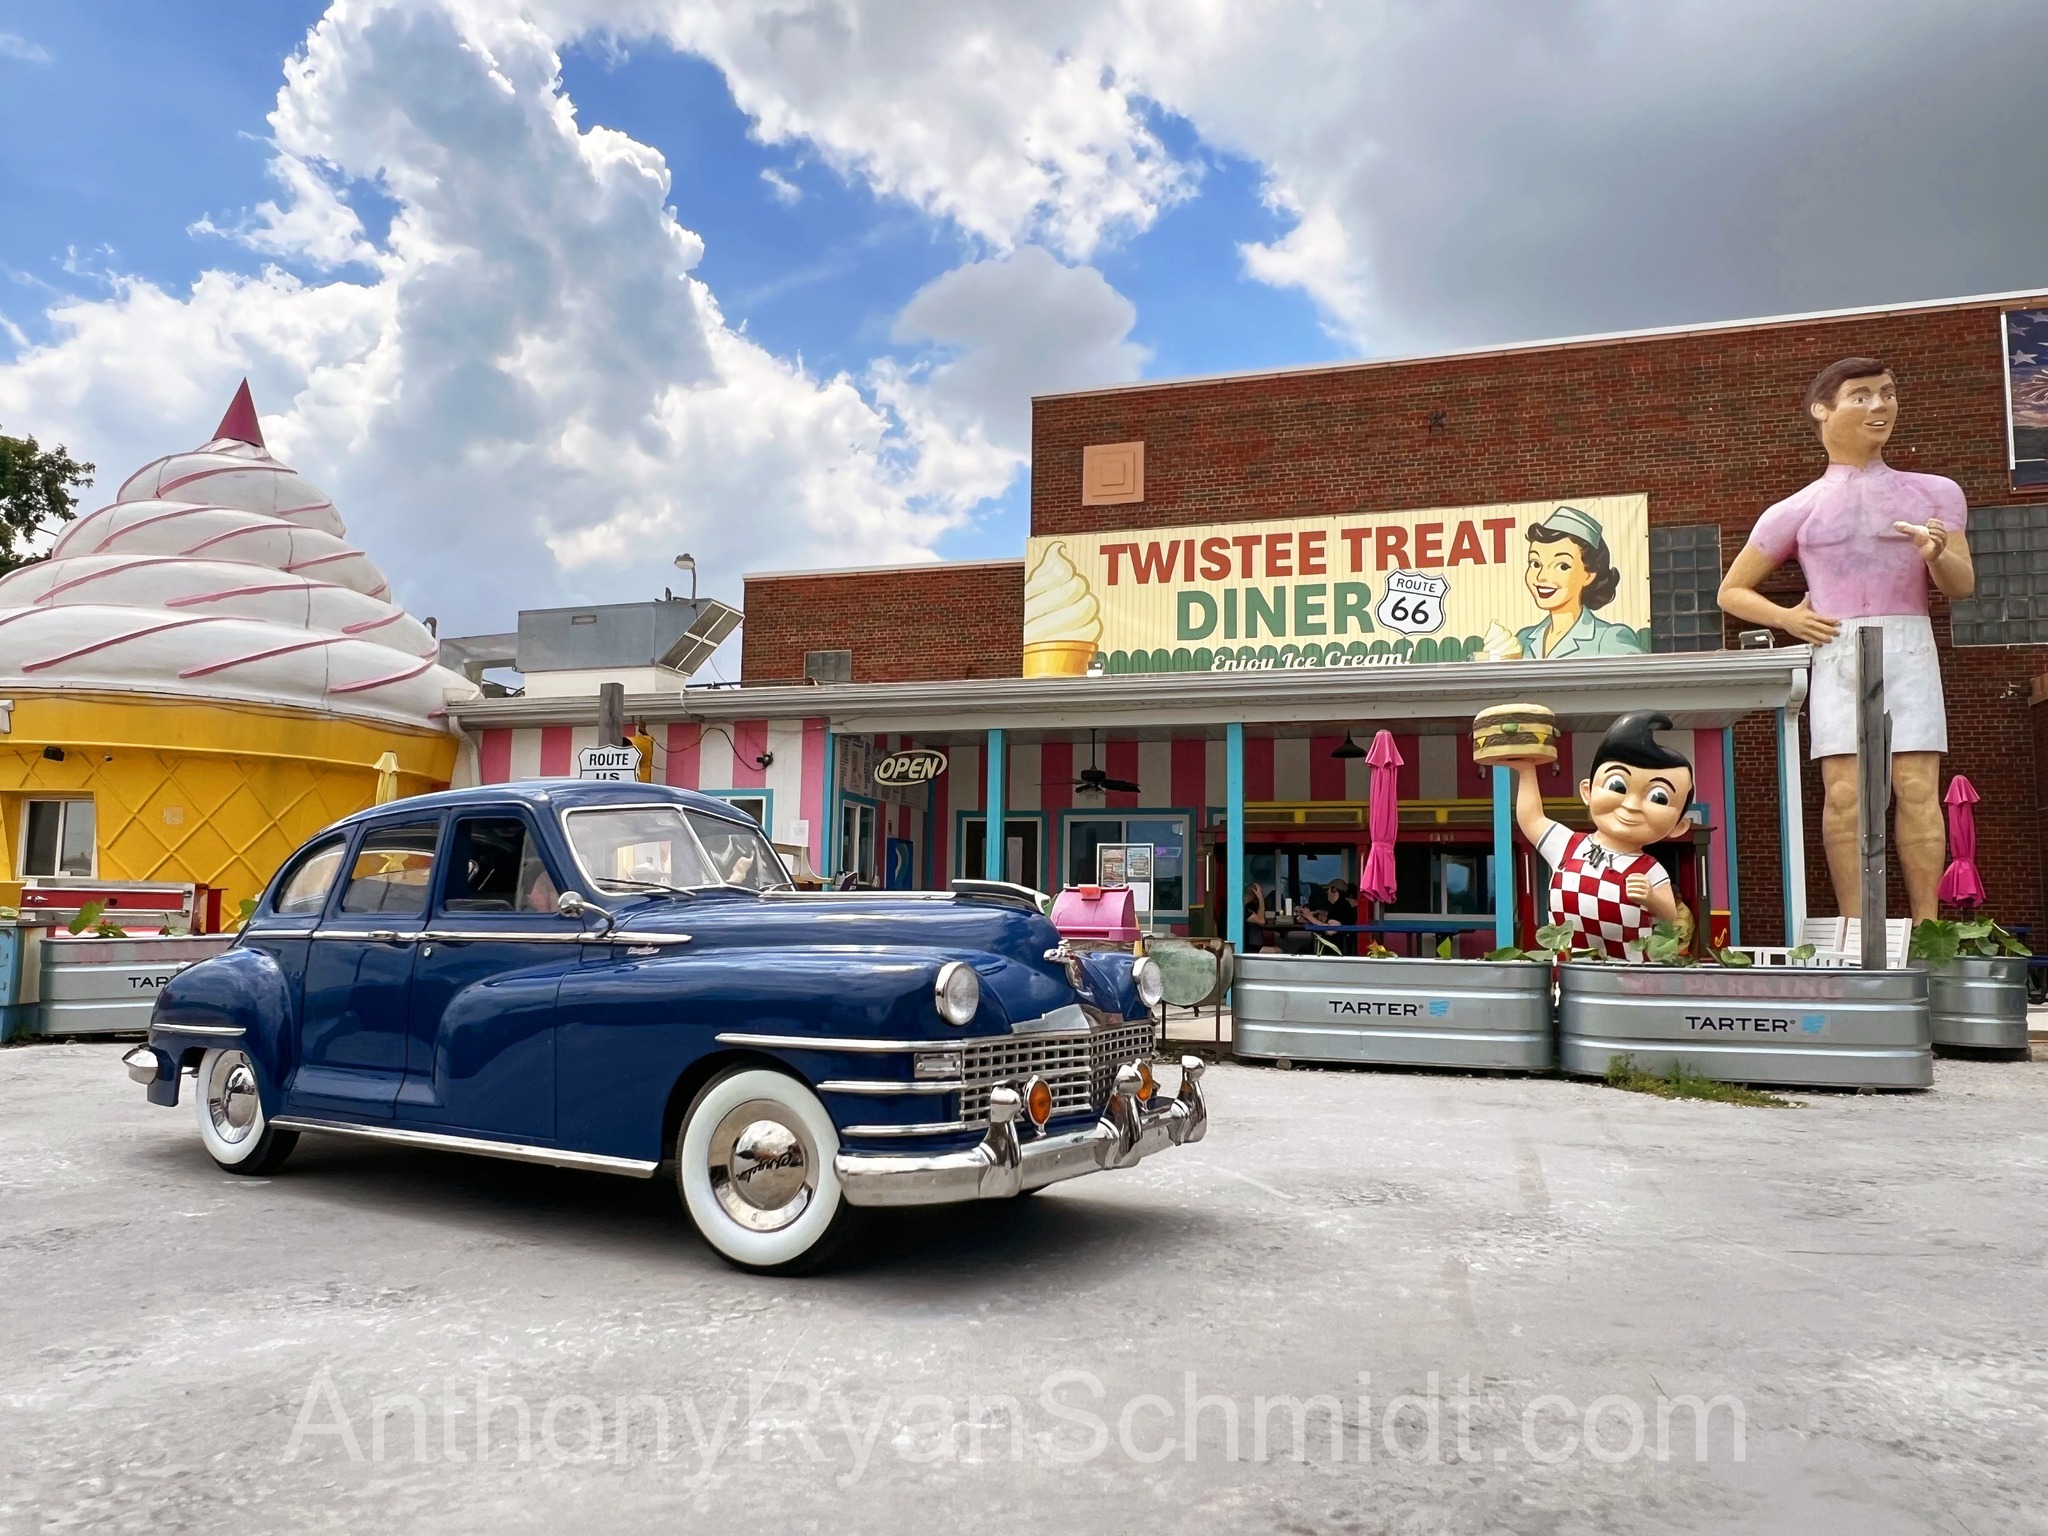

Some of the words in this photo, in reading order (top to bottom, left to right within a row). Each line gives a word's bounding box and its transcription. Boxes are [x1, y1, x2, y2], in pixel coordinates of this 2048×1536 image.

[1100, 530, 1327, 586] TWISTEE
[1341, 517, 1516, 572] TREAT
[1396, 578, 1437, 593] ROUTE
[1177, 581, 1375, 641] DINER
[1391, 596, 1429, 625] 66
[1281, 652, 1317, 669] Ice
[1324, 648, 1413, 667] Cream!
[589, 753, 629, 766] ROUTE
[879, 757, 939, 779] OPEN
[596, 772, 620, 780] US
[128, 976, 171, 988] TAR
